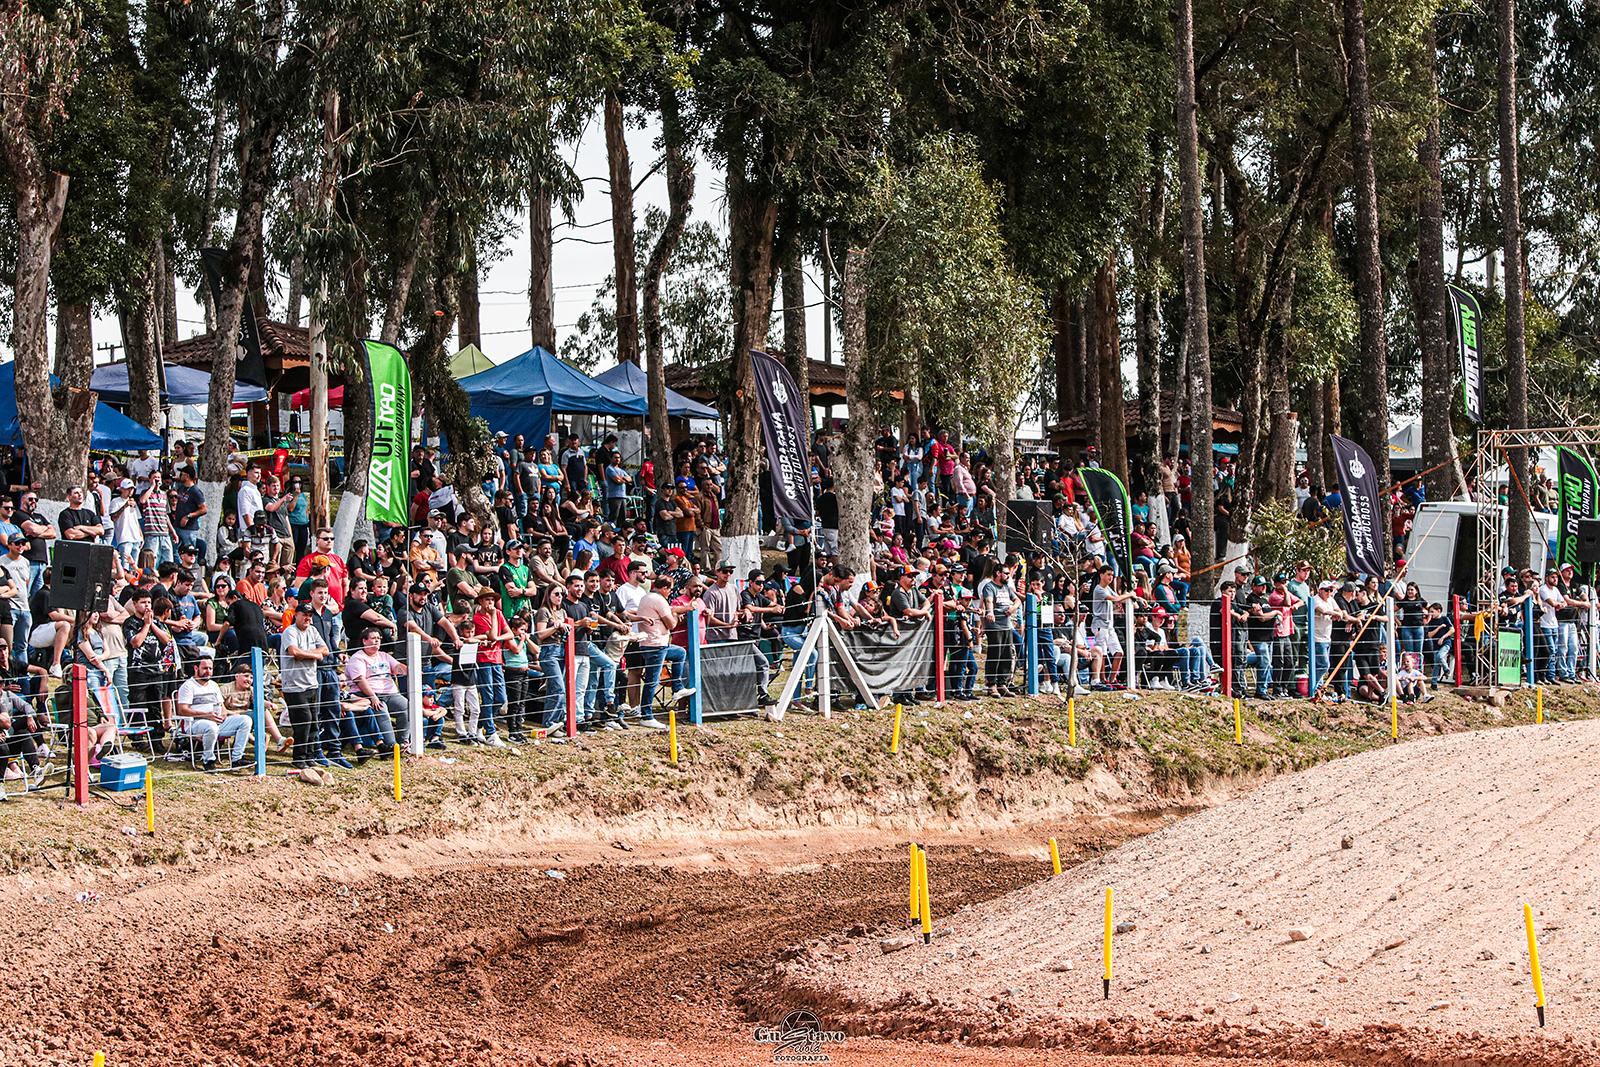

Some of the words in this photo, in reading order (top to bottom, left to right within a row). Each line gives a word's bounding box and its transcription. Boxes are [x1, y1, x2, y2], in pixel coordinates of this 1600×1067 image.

[1460, 303, 1480, 415] SPORTBAY
[395, 383, 406, 432] COMPANY
[1582, 478, 1592, 515] COMPANY
